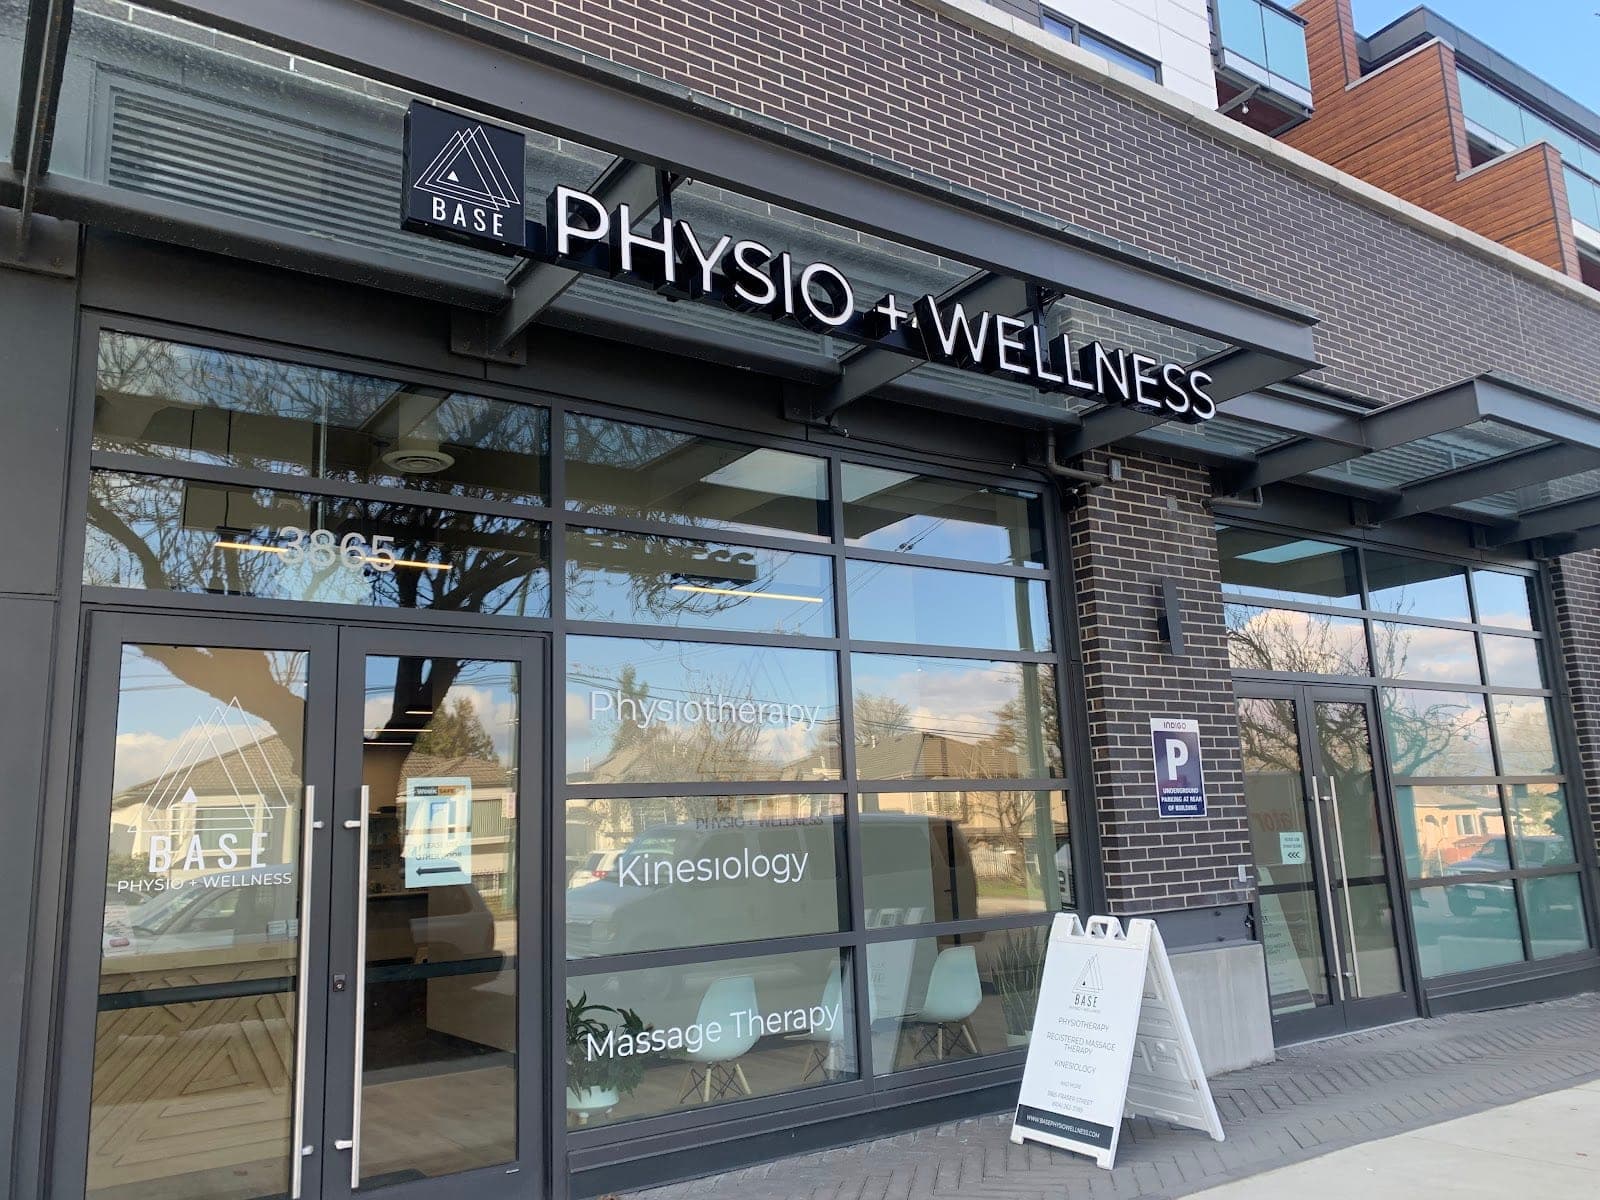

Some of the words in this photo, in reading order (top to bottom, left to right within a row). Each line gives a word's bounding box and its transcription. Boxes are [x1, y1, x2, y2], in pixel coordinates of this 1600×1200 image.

[433, 196, 504, 237] BASE
[556, 184, 855, 326] PHYSIO
[877, 293, 908, 331] +
[927, 295, 1217, 421] WELLNESS
[278, 525, 396, 572] 3865
[590, 689, 821, 732] Physiotherapy
[1165, 738, 1189, 781] P
[1167, 804, 1174, 812] OF
[148, 831, 269, 873] BASE
[618, 847, 809, 889] Kinesiology
[116, 877, 184, 894] PHYSIO
[202, 872, 293, 889] WELLNESS
[1073, 993, 1099, 1008] BASE
[586, 1020, 722, 1062] Massage
[729, 1002, 840, 1039] Therapy
[1047, 1031, 1085, 1046] REGISTERED
[1085, 1038, 1117, 1052] MASSAGE
[1057, 1016, 1110, 1032] PHYSIOTHERAPY
[1054, 1059, 1097, 1074] KINESIOLOGY
[1063, 1043, 1094, 1056] THERAPY
